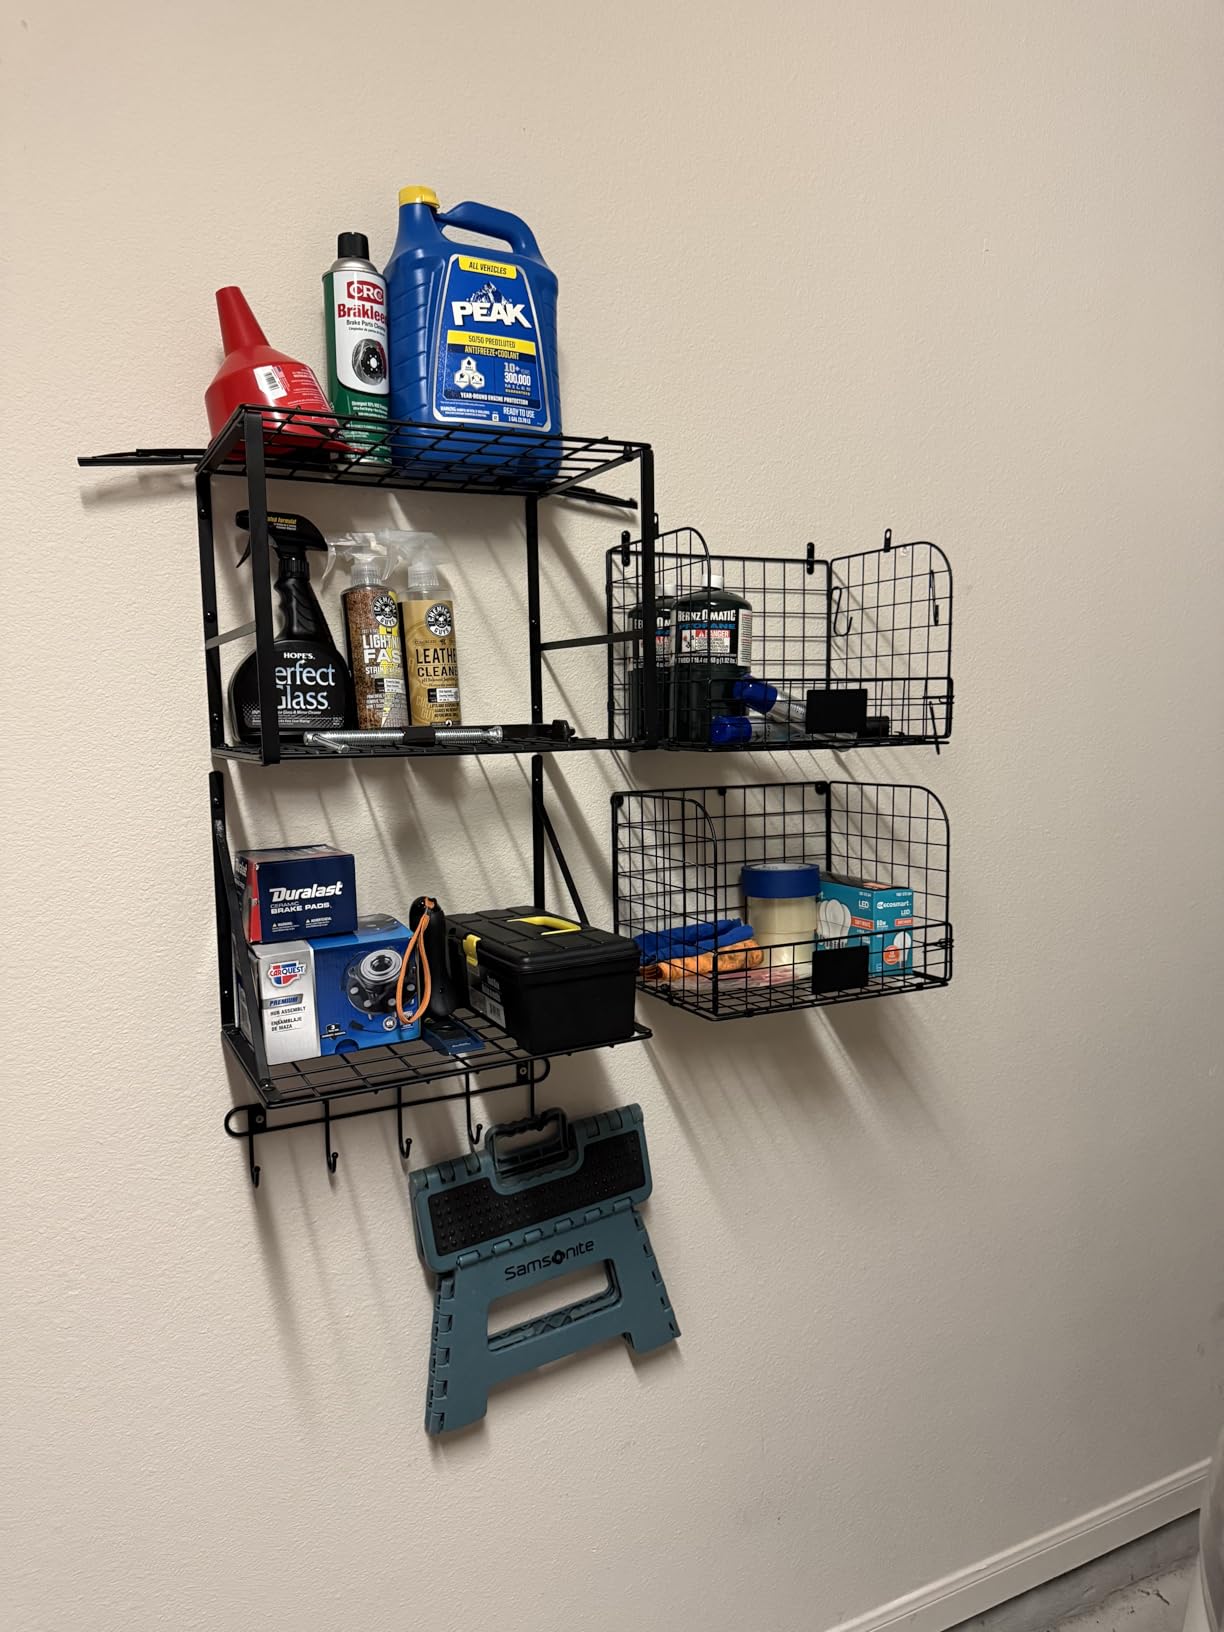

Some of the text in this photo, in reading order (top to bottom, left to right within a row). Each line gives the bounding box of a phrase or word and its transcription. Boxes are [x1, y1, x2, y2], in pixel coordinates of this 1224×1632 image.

[480, 264, 507, 275] VEHICLES
[349, 284, 383, 302] CRC
[451, 301, 532, 328] PEAK
[468, 335, 516, 349] 50/50 PREDILUTED
[504, 373, 532, 387] 300,000
[503, 407, 535, 419] READY TO USE
[434, 627, 449, 635] GUYS
[362, 634, 400, 649] LIGHTN
[363, 649, 401, 664] FAS
[416, 648, 457, 664] LEATHE
[275, 660, 336, 686] erfect
[417, 666, 458, 678] CLEANE
[269, 881, 343, 903] Duralast
[270, 901, 300, 909] CERAMIC
[270, 902, 330, 915] BRAKE PADS
[858, 900, 869, 909] LED
[883, 900, 910, 909] ecosmart
[269, 965, 305, 977] CARQUEST
[269, 996, 299, 1007] PREMIUM
[281, 1006, 306, 1014] ASSEMBLY
[271, 1016, 302, 1026] ENSAMBLAJE
[278, 1023, 293, 1031] MAZA
[504, 1240, 595, 1281] Samsonite
